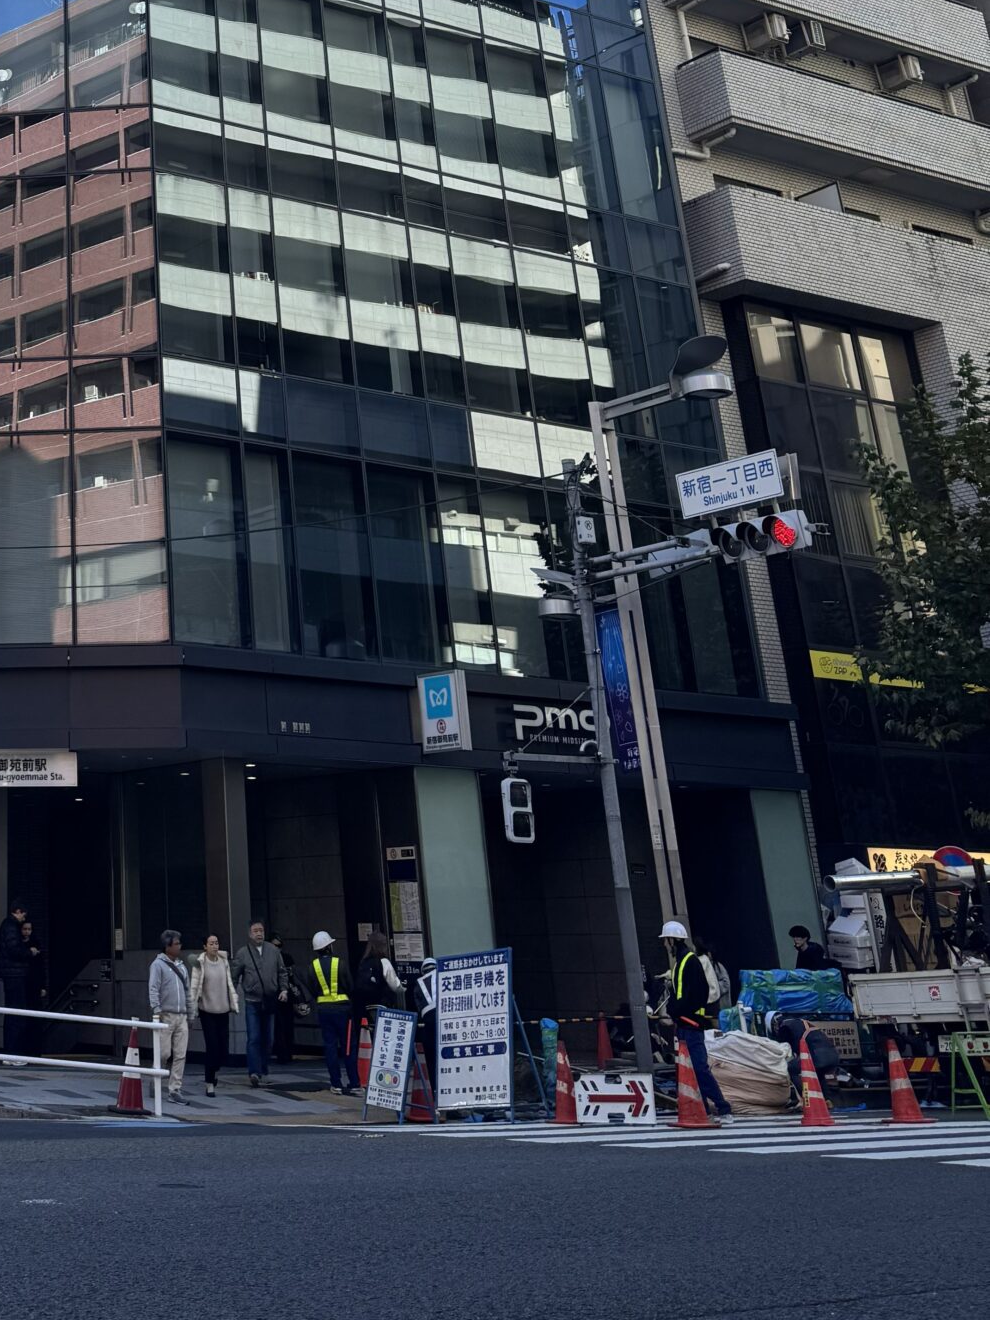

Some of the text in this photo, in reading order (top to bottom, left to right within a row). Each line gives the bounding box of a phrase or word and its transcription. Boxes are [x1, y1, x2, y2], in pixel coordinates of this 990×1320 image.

[682, 458, 774, 498] 新宿一丁目西
[704, 484, 759, 507] Shinjuku 1 W.
[441, 969, 505, 992] 交通信号機を
